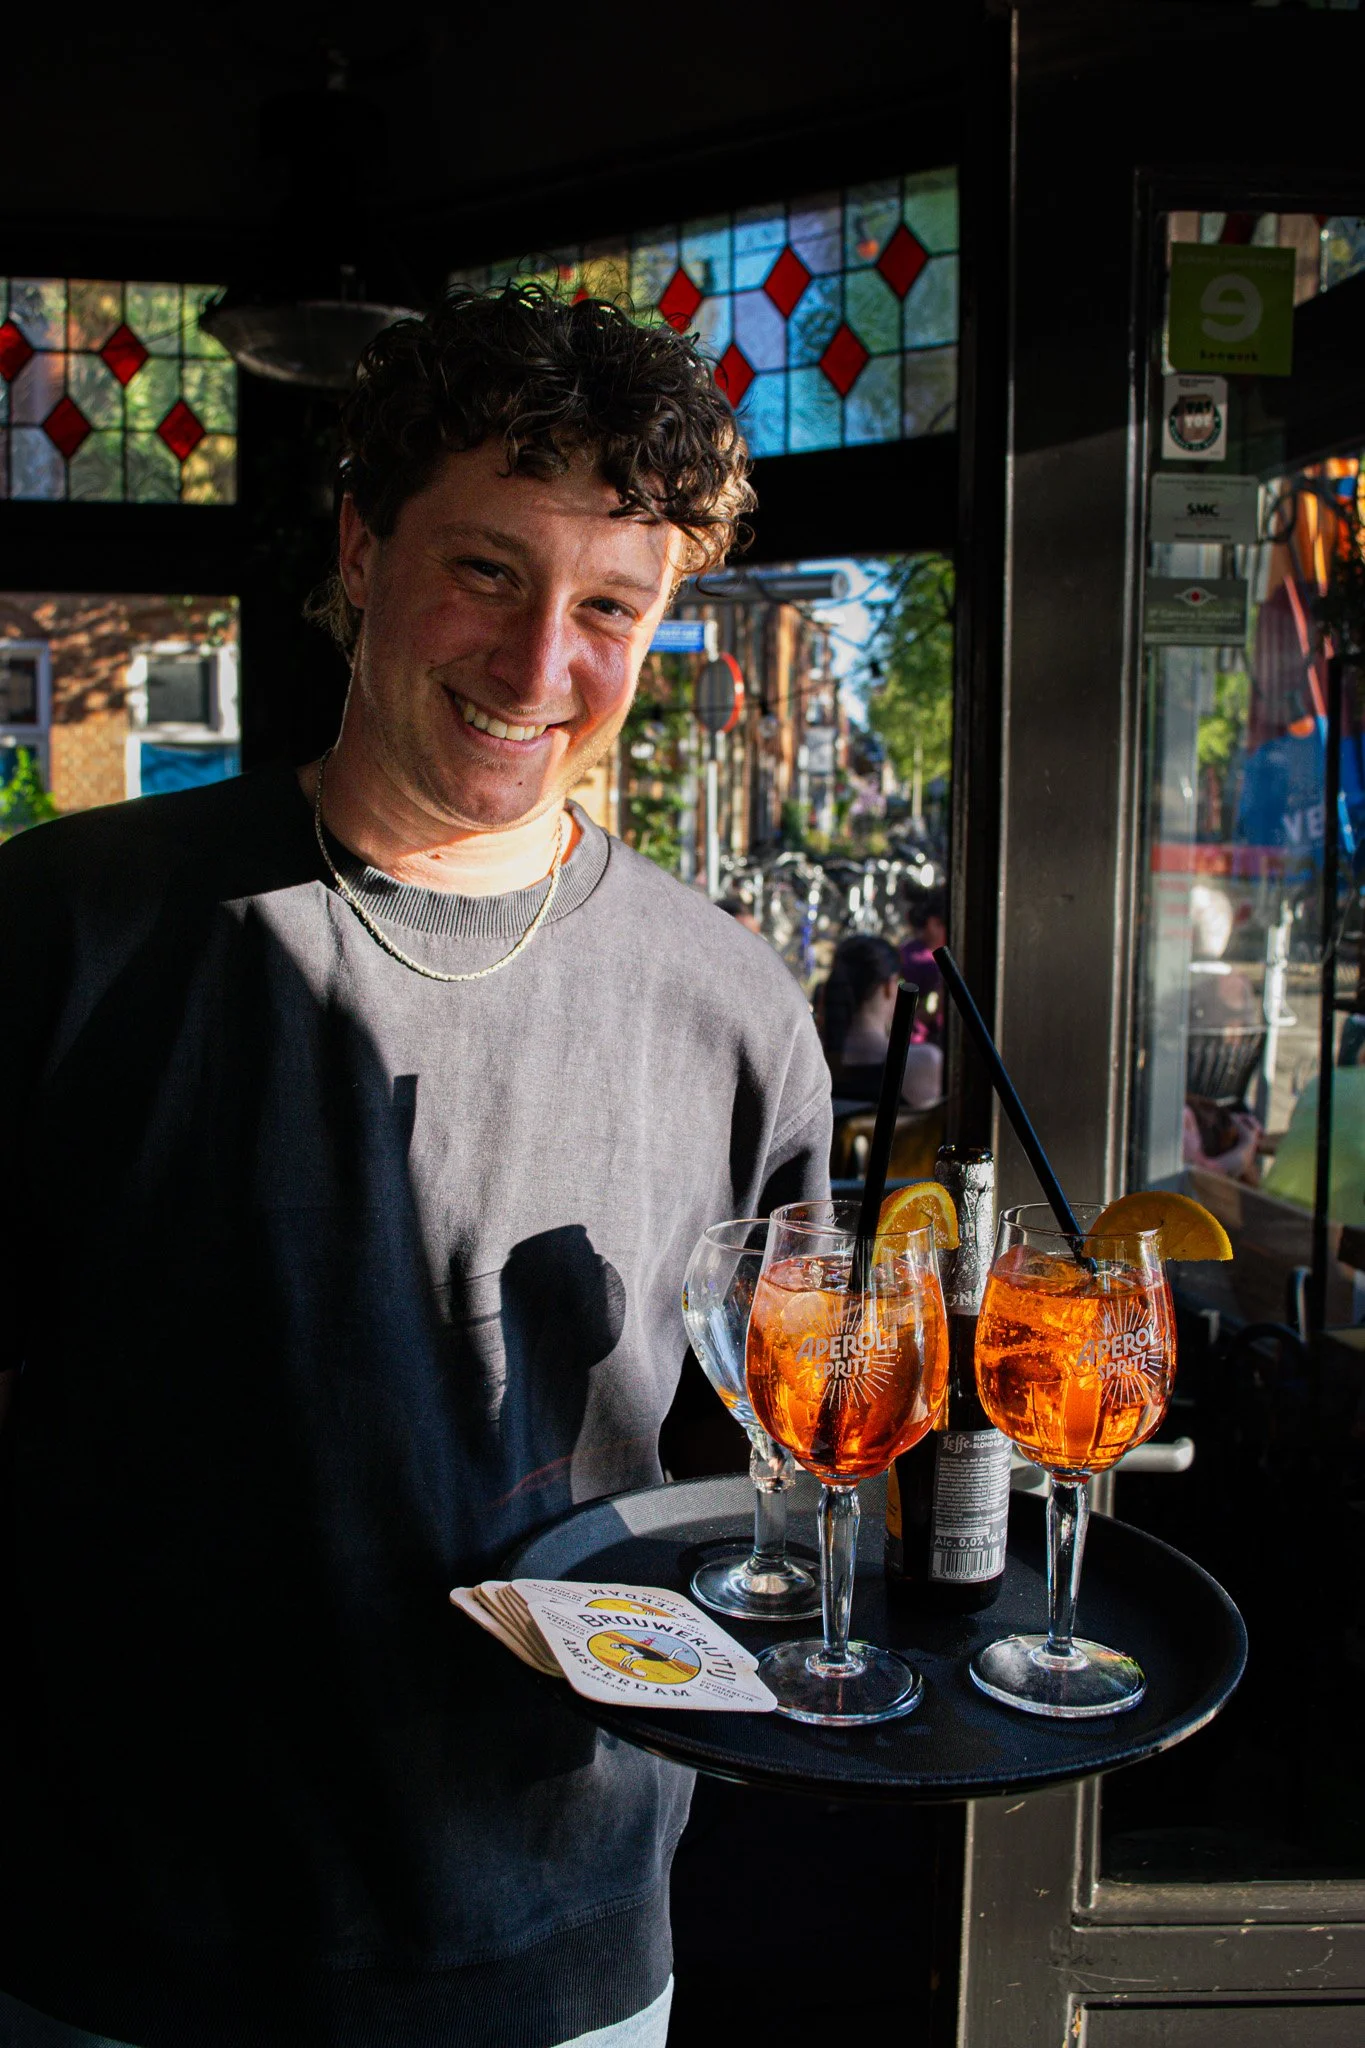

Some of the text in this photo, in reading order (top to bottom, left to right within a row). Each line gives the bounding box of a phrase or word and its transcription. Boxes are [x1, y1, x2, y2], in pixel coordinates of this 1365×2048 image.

[1187, 503, 1220, 517] SMC
[796, 1329, 888, 1363] APEROL
[1076, 1324, 1157, 1367] APEROL
[814, 1356, 872, 1380] SPRITZ
[1098, 1351, 1148, 1380] SPRITZ
[958, 1535, 985, 1549] 0,0%
[588, 1588, 701, 1624] STERDAM
[578, 1614, 727, 1658] BROUWERIJ
[562, 1637, 692, 1697] AMSTERDAM
